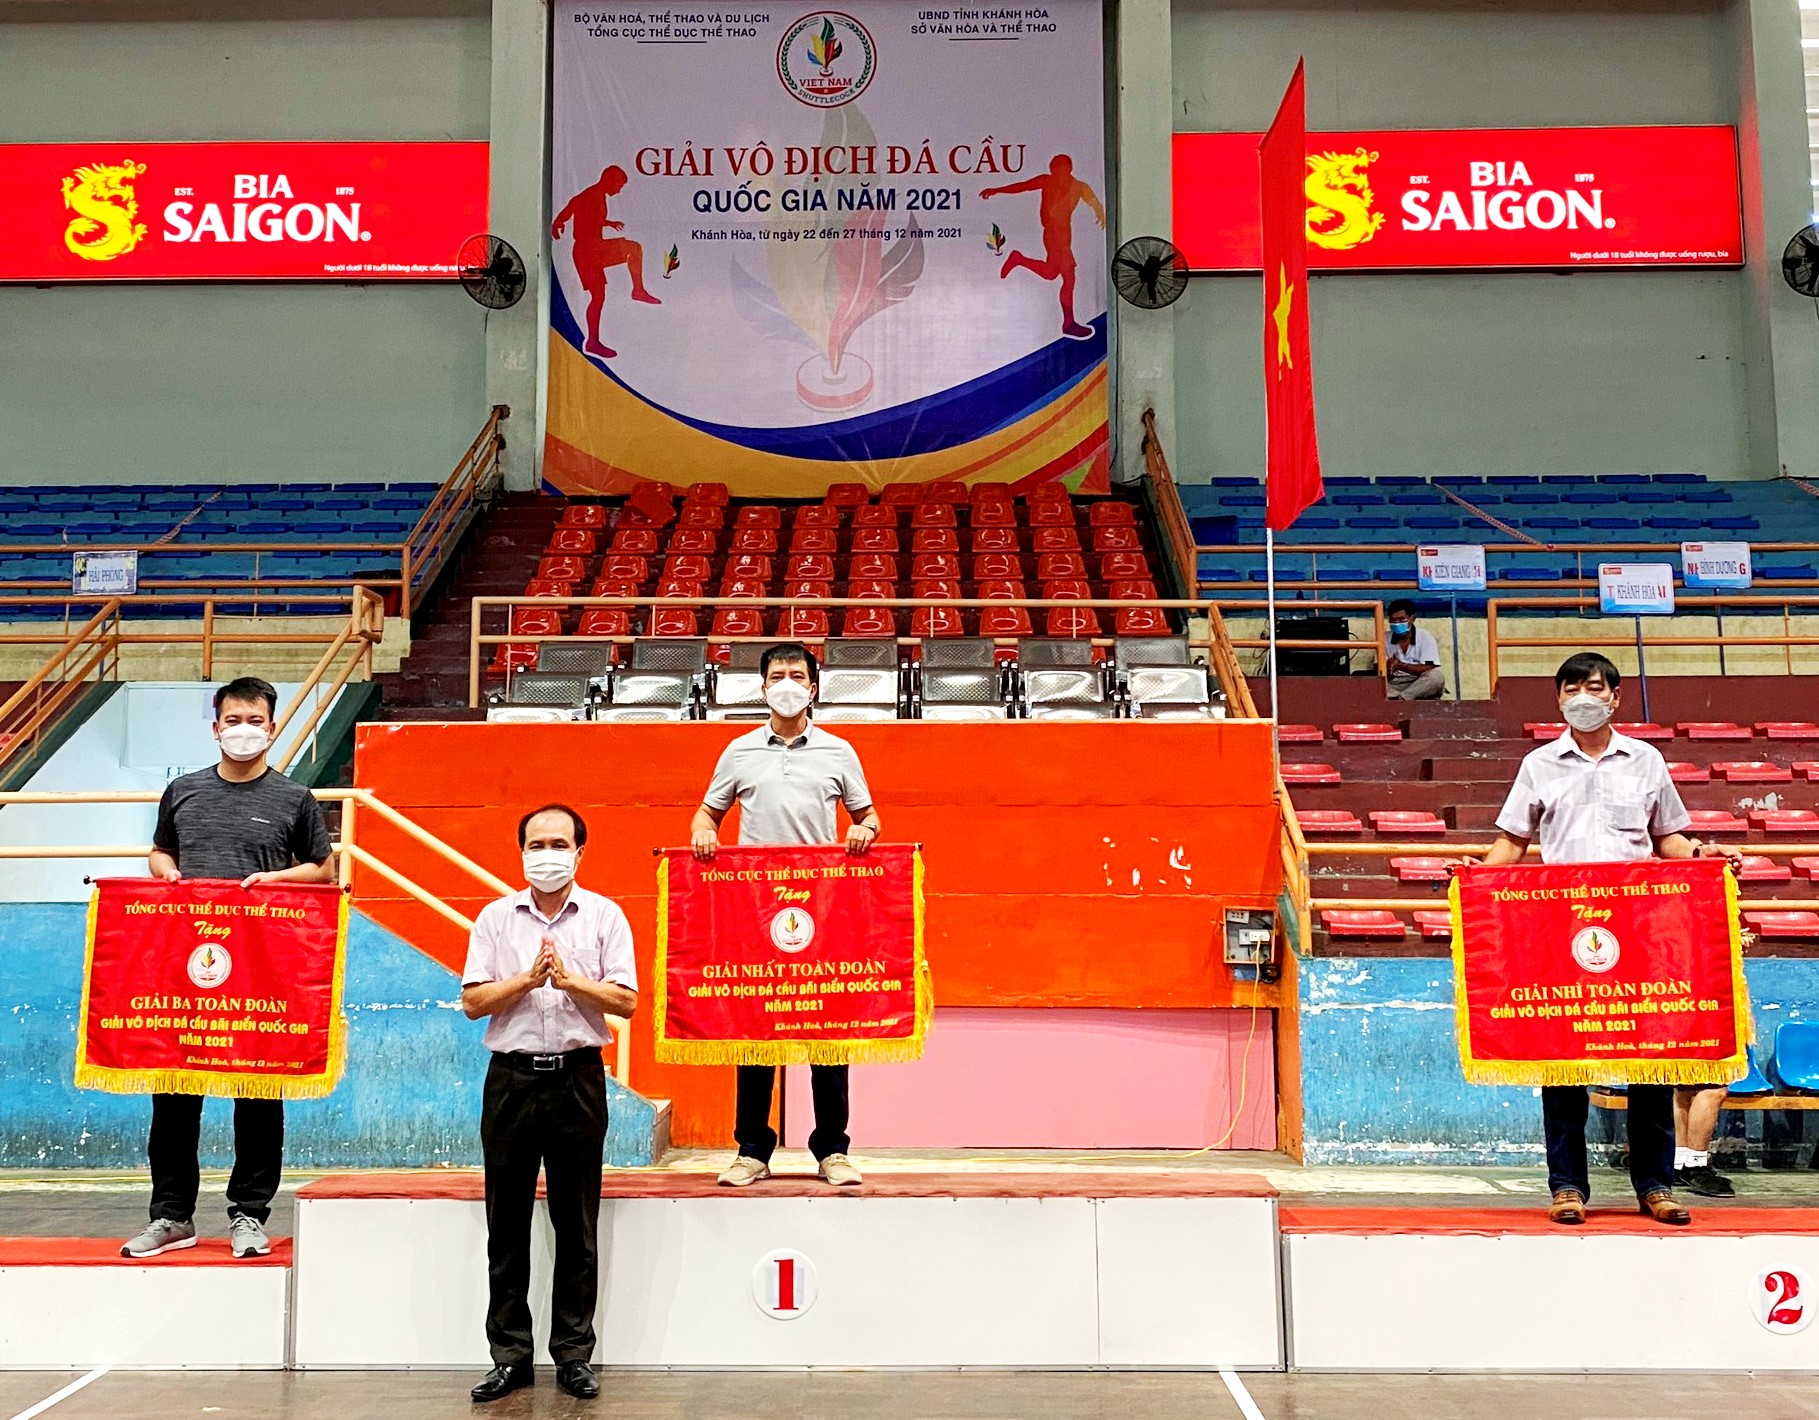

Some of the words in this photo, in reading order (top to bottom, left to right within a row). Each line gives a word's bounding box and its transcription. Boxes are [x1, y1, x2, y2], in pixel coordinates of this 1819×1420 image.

[574, 13, 590, 25] BỘ
[593, 14, 616, 23] VĂN
[649, 11, 671, 23] THỂ
[674, 15, 704, 23] THAO
[708, 13, 721, 23] VÀ
[726, 15, 741, 23] DU
[744, 14, 770, 24] LỊCH
[919, 11, 949, 19] UBND
[953, 8, 979, 19] TỈNH
[983, 9, 1021, 19] KHÁNH
[1025, 8, 1048, 19] HÒA
[588, 25, 618, 37] TỔNG
[622, 28, 645, 39] CỤC
[649, 25, 671, 37] THỂ
[674, 28, 697, 39] DỤC
[701, 25, 722, 37] THỂ
[726, 28, 756, 37] THAO
[911, 24, 927, 34] SỞ
[930, 24, 952, 33] VĂN
[983, 22, 997, 33] VÀ
[1001, 20, 1022, 32] THỂ
[1026, 24, 1056, 32] THAO
[828, 78, 852, 86] NAM
[798, 88, 855, 103] SHUTTLECOCK
[635, 140, 714, 176] GIẢI
[724, 140, 773, 176] VÔ
[784, 145, 876, 182] ĐỊCH
[887, 138, 939, 174] ĐÁ
[949, 135, 1026, 174] CẦU
[1410, 175, 1431, 184] EST.
[1470, 161, 1533, 186] BIA
[1575, 173, 1594, 182] 1875
[174, 187, 194, 196] EST.
[234, 174, 294, 198] BIA
[335, 187, 354, 195] 1875
[693, 181, 771, 213] QUỐC
[782, 189, 827, 211] GIA
[838, 182, 896, 210] NĂM
[906, 188, 961, 210] 2021
[1401, 189, 1603, 231] SAIGON
[163, 201, 361, 242] SAIGON
[692, 229, 727, 240] Khánh
[731, 229, 755, 241] Hòa,
[759, 229, 771, 239] từ
[773, 230, 799, 241] ngày
[803, 230, 816, 239] 22
[819, 228, 839, 239] đến
[843, 229, 856, 239] 27
[859, 228, 890, 240] tháng
[895, 229, 906, 238] 12
[910, 228, 933, 238] năm
[938, 228, 961, 238] 2021
[700, 868, 734, 882] TỔNG
[737, 871, 762, 882] CỤC
[765, 866, 791, 880] THỂ
[793, 869, 818, 880] DỤC
[821, 863, 847, 877] THỂ
[849, 866, 884, 877] THAO
[773, 886, 811, 903] Tặng
[1492, 887, 1528, 901] TỔNG
[1531, 889, 1559, 901] CỤC
[1561, 884, 1588, 898] THỂ
[1591, 887, 1618, 899] DỤC
[1621, 881, 1649, 896] THỂ
[1651, 883, 1690, 894] THAO
[125, 901, 156, 915] TỔNG
[159, 904, 185, 915] CỤC
[188, 901, 212, 915] THỂ
[215, 905, 241, 917] DỤC
[243, 903, 268, 917] THỂ
[270, 907, 306, 919] THAO
[1571, 904, 1612, 922] Tặng
[194, 921, 231, 940] Tặng
[703, 961, 738, 978] GIẢI
[741, 960, 785, 978] NHẤT
[789, 960, 835, 976] TOÀN
[840, 958, 886, 975] ĐOÀN
[689, 983, 711, 997] GIẢI
[714, 984, 730, 996] VÔ
[733, 983, 755, 999] ĐỊCH
[776, 981, 796, 995] CẦU
[799, 981, 817, 995] BÃI
[820, 977, 844, 993] BIỂN
[847, 977, 879, 993] QUỐC
[881, 979, 901, 991] GIA
[1511, 984, 1548, 1001] GIẢI
[1552, 982, 1583, 1000] NHÌ
[1587, 980, 1636, 998] TOÀN
[1641, 978, 1692, 996] ĐOÀN
[131, 993, 168, 1010] GIẢI
[172, 996, 191, 1009] BA
[195, 995, 241, 1011] TOÀN
[245, 996, 287, 1013] ĐOÀN
[764, 999, 792, 1013] NĂM
[795, 1000, 823, 1011] 2021
[1490, 1003, 1515, 1018] GIẢI
[1517, 1004, 1535, 1017] VÔ
[1538, 1003, 1562, 1020] ĐỊCH
[1584, 1000, 1605, 1015] CẦU
[1609, 1001, 1628, 1015] BÃI
[1632, 998, 1657, 1013] BIỂN
[1661, 997, 1695, 1014] QUỐC
[1698, 1000, 1719, 1011] GIA
[101, 1015, 123, 1029] GIẢI
[126, 1016, 143, 1028] VÔ
[146, 1015, 171, 1031] ĐỊCH
[210, 1019, 228, 1031] BÃI
[231, 1016, 256, 1031] BIỂN
[258, 1018, 286, 1033] QUỐC
[289, 1023, 308, 1035] GIA
[1573, 1019, 1603, 1032] NĂM
[1606, 1020, 1636, 1031] 2021
[179, 1033, 202, 1045] NĂM
[205, 1036, 234, 1047] 2021
[773, 1258, 799, 1310] 1
[1765, 1271, 1803, 1324] 2
